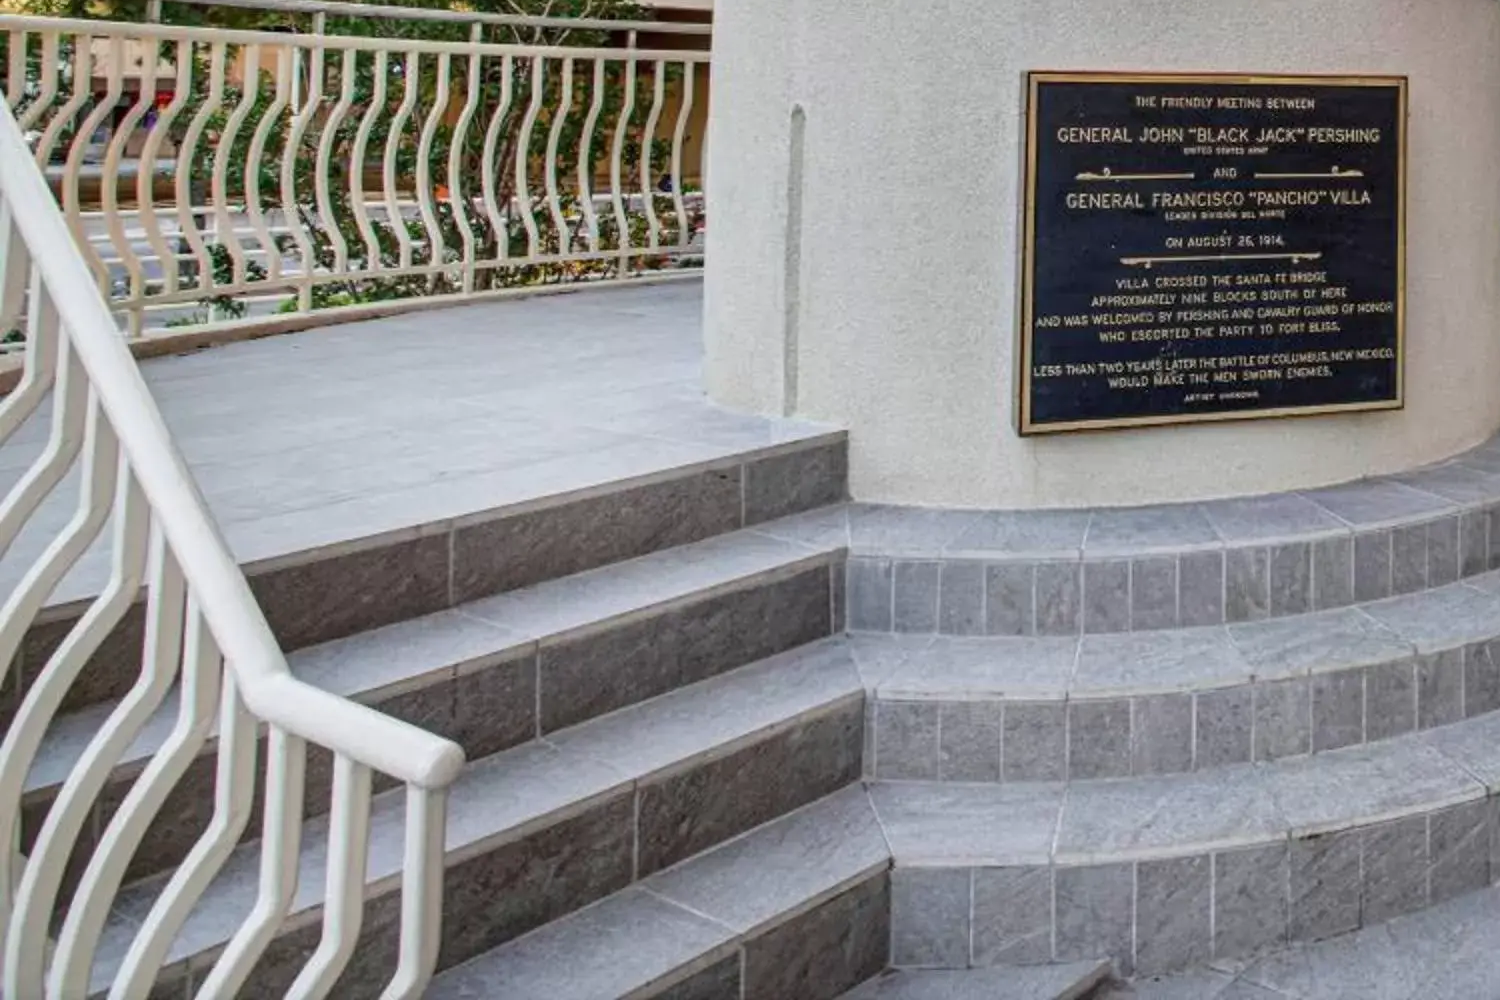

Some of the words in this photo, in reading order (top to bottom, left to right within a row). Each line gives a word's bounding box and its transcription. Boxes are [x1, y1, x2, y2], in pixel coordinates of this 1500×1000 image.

[1136, 96, 1156, 107] THE
[1162, 97, 1213, 108] FRIENDLY
[1217, 98, 1262, 109] MEETING
[1266, 98, 1315, 110] BETWEEN
[1057, 127, 1132, 143] GENERAL
[1139, 127, 1184, 143] JOHN
[1188, 127, 1249, 143] "BLACK
[1256, 127, 1305, 143] JACK"
[1308, 127, 1380, 143] PERSHING
[1213, 167, 1237, 179] AND
[1066, 192, 1144, 209] GENERAL
[1152, 191, 1244, 207] FRANCISCO
[1249, 190, 1326, 206] "PANCHO"
[1330, 190, 1371, 204] VILLA
[1165, 237, 1183, 248] ON
[1187, 236, 1232, 248] AUGUST
[1116, 278, 1149, 290] VILLA
[1156, 275, 1207, 288] CROSSED
[1212, 275, 1231, 287] THE
[1236, 274, 1271, 286] SANTA
[1275, 272, 1288, 284] FE
[1290, 272, 1327, 284] BRIDGE
[1091, 293, 1177, 307] APPROXIMATELY
[1181, 293, 1208, 305] NINE
[1213, 291, 1256, 303] BLOCKS
[1261, 289, 1298, 301] SOUTH
[1304, 288, 1316, 299] OF
[1321, 286, 1347, 298] HERE
[1036, 315, 1061, 328] AND
[1064, 314, 1088, 327] WAS
[1092, 312, 1154, 325] WELCOMED
[1158, 311, 1173, 322] BY
[1176, 309, 1229, 322] PERSHING
[1231, 308, 1254, 320] AND
[1257, 306, 1301, 318] CAVALRY
[1304, 304, 1338, 316] GUARD
[1342, 304, 1354, 314] OF
[1357, 301, 1393, 314] HONOR
[1100, 331, 1125, 343] WHO
[1131, 328, 1190, 342] ESCORTED
[1194, 326, 1215, 338] THE
[1219, 325, 1254, 337] PARTY
[1260, 324, 1273, 335] TO
[1279, 323, 1305, 334] FORT
[1308, 322, 1341, 333] BLISS.
[1034, 365, 1062, 377] LESS
[1066, 364, 1095, 376] THAN
[1099, 362, 1123, 374] TWO
[1126, 359, 1162, 373] YEARS
[1166, 358, 1196, 370] LATER
[1199, 357, 1217, 369] THE
[1220, 356, 1256, 368] BATTLE
[1257, 354, 1270, 365] OF
[1332, 350, 1354, 361] NEW
[1108, 376, 1149, 389] WOULD
[1153, 374, 1184, 386] MAKE
[1188, 372, 1208, 384] THE
[1213, 371, 1237, 382] MEN
[1242, 368, 1282, 381] SWORN
